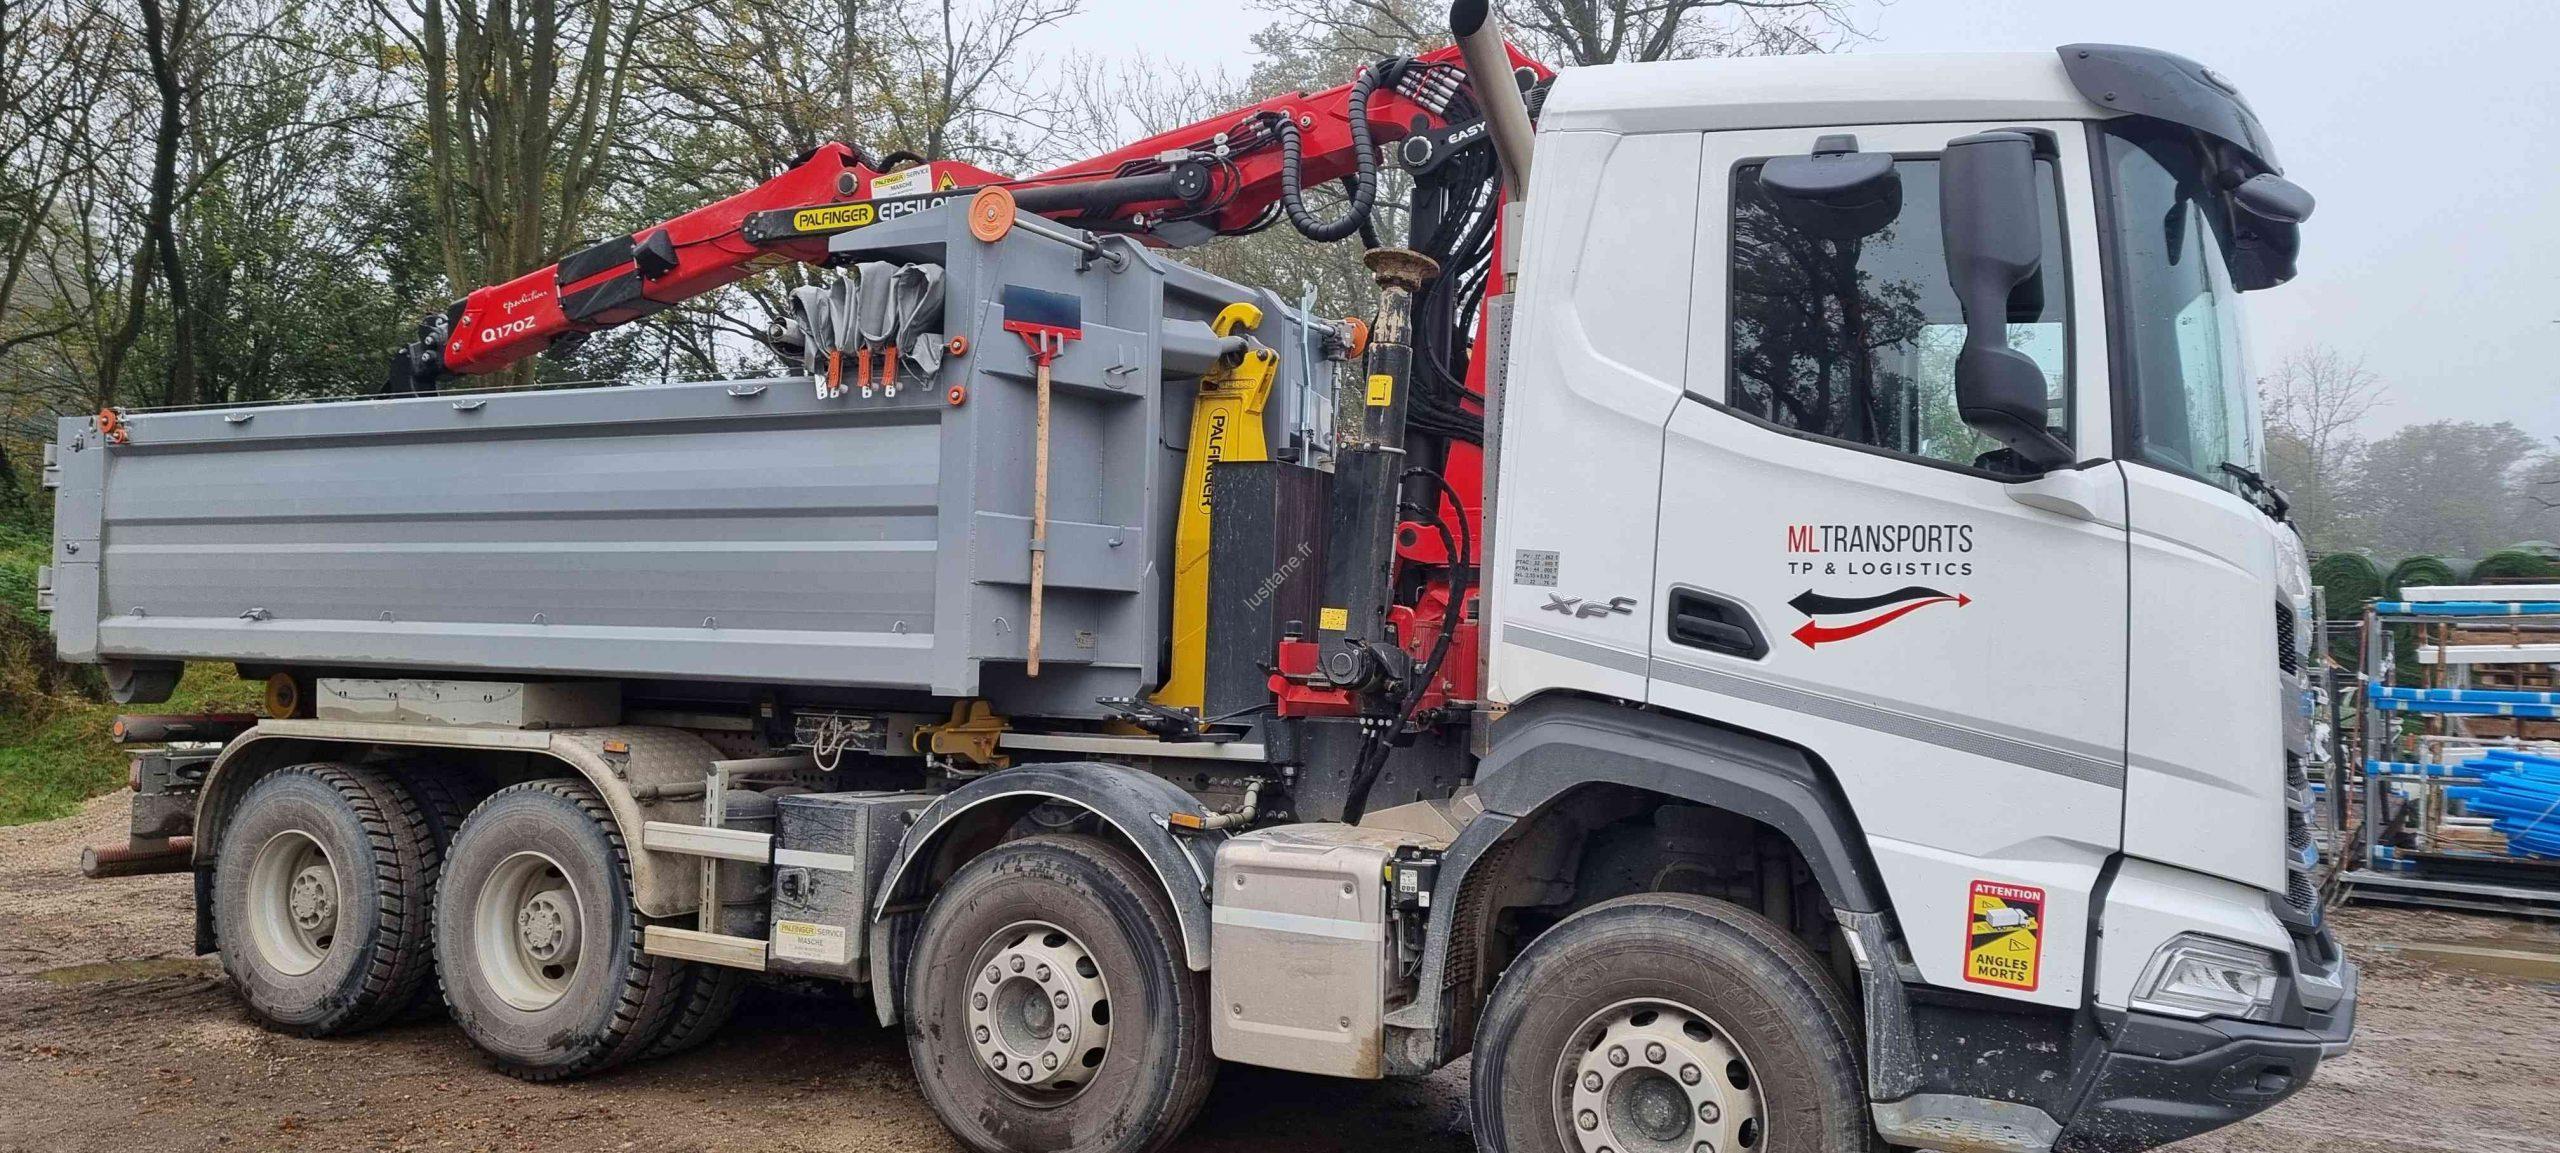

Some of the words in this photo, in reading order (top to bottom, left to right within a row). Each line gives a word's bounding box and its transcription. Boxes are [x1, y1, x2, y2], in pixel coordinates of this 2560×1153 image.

[1448, 121, 1486, 144] EASY
[800, 208, 868, 227] PALFINGER
[878, 197, 950, 221] EPSILO
[481, 315, 536, 343] Q170Z
[1788, 524, 1973, 552] MLTRANSPORTS
[1788, 562, 1813, 575] TP
[1825, 562, 1836, 575] &
[1849, 562, 1972, 575] LOGISTICS
[1975, 884, 2041, 900] ATTENTION
[817, 928, 843, 938] SERVICE
[1976, 954, 2028, 970] ANGLES
[1978, 966, 2025, 981] MORTS
